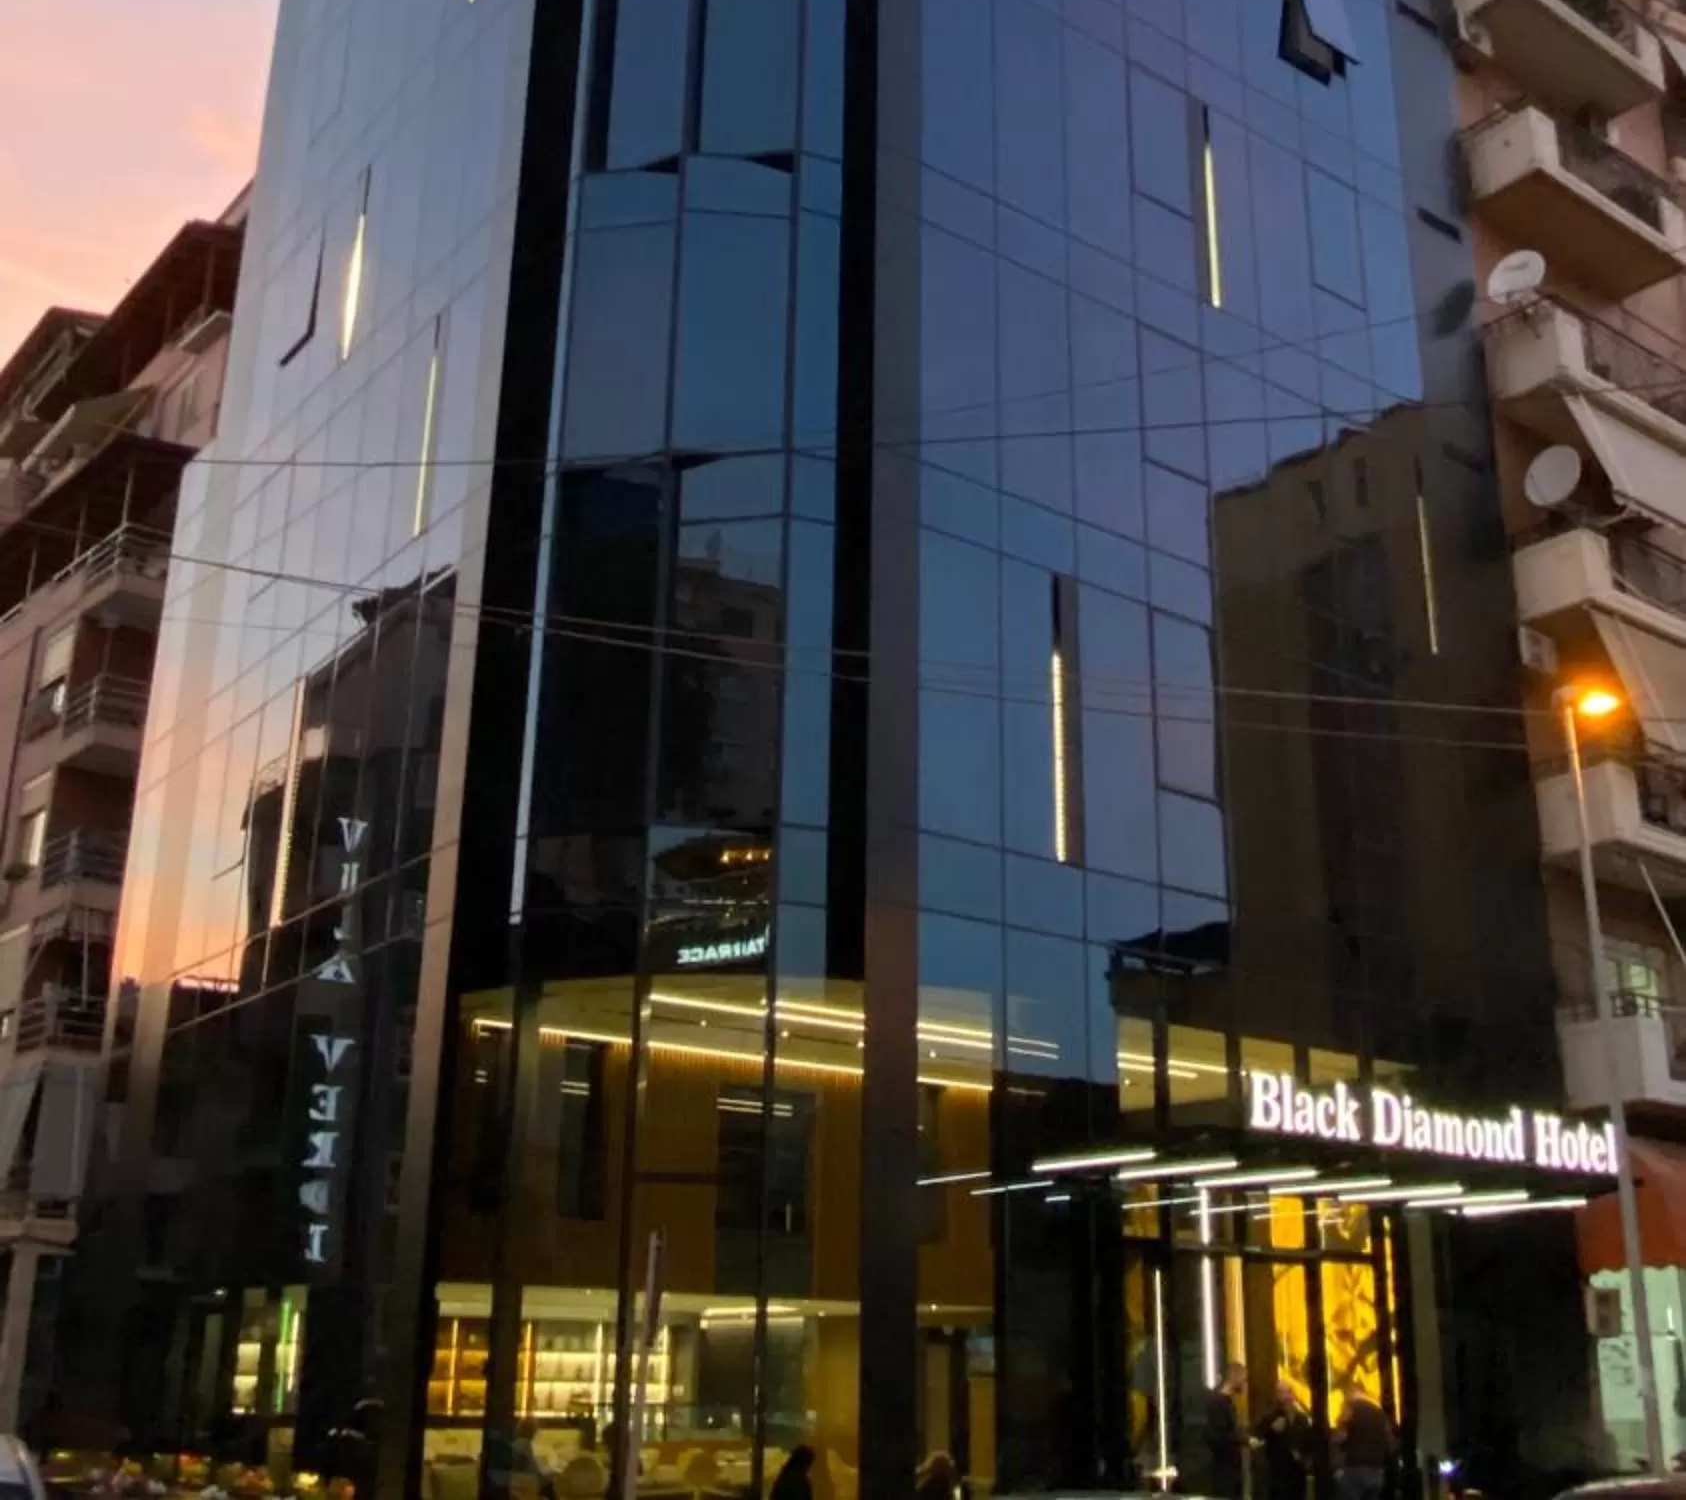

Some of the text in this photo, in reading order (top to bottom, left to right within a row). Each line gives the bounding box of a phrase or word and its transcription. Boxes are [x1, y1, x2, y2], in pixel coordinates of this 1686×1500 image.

[1250, 1070, 1619, 1174] Black Diamond Hotel
